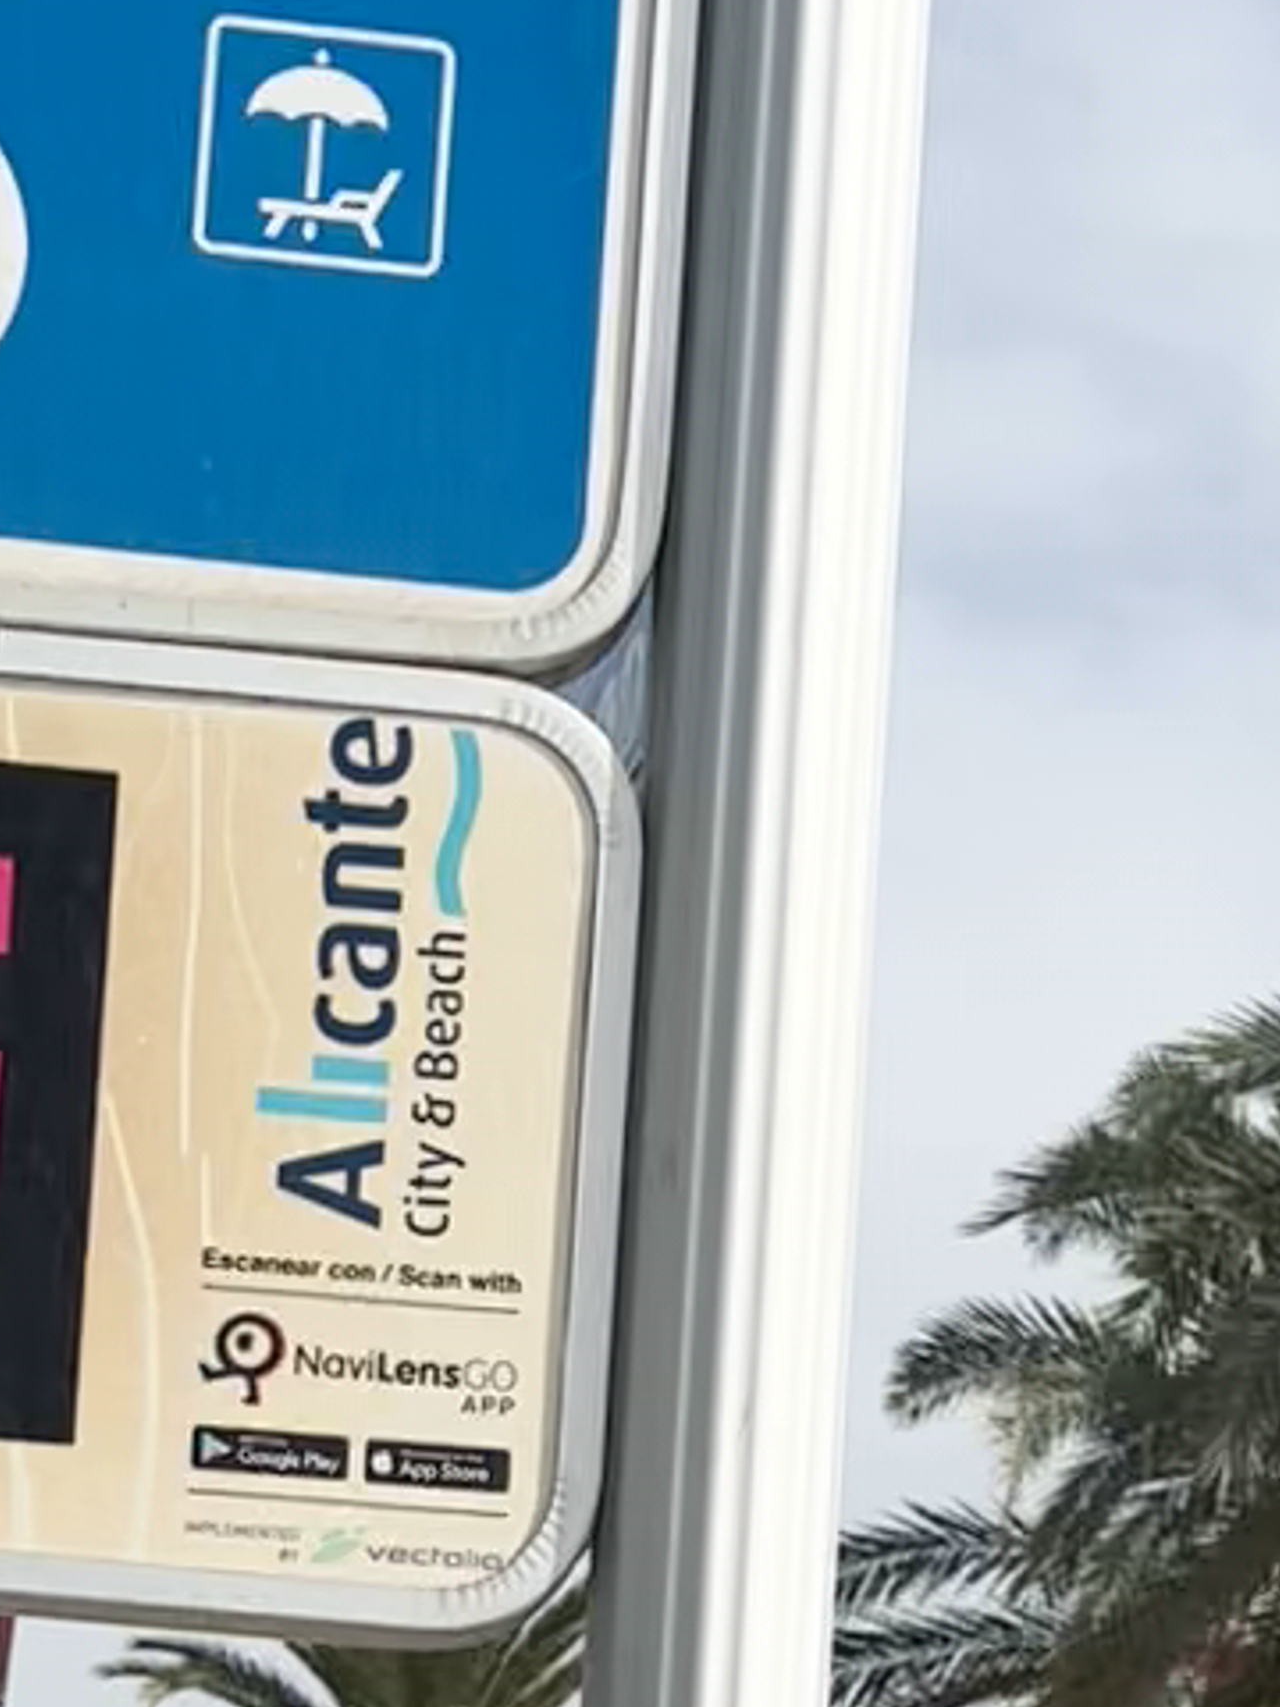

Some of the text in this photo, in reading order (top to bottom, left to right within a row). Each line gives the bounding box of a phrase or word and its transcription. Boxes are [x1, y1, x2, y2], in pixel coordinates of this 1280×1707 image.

[256, 717, 414, 1229] Alicante
[404, 929, 466, 1236] City & Beach
[201, 1247, 320, 1275] Escanear
[329, 1262, 376, 1282] con
[399, 1265, 461, 1289] Scan
[468, 1273, 522, 1293] with
[293, 1345, 518, 1392] NaviLensGO
[461, 1395, 515, 1414] APP
[237, 1445, 340, 1475] Google Play
[399, 1460, 489, 1481] App Store
